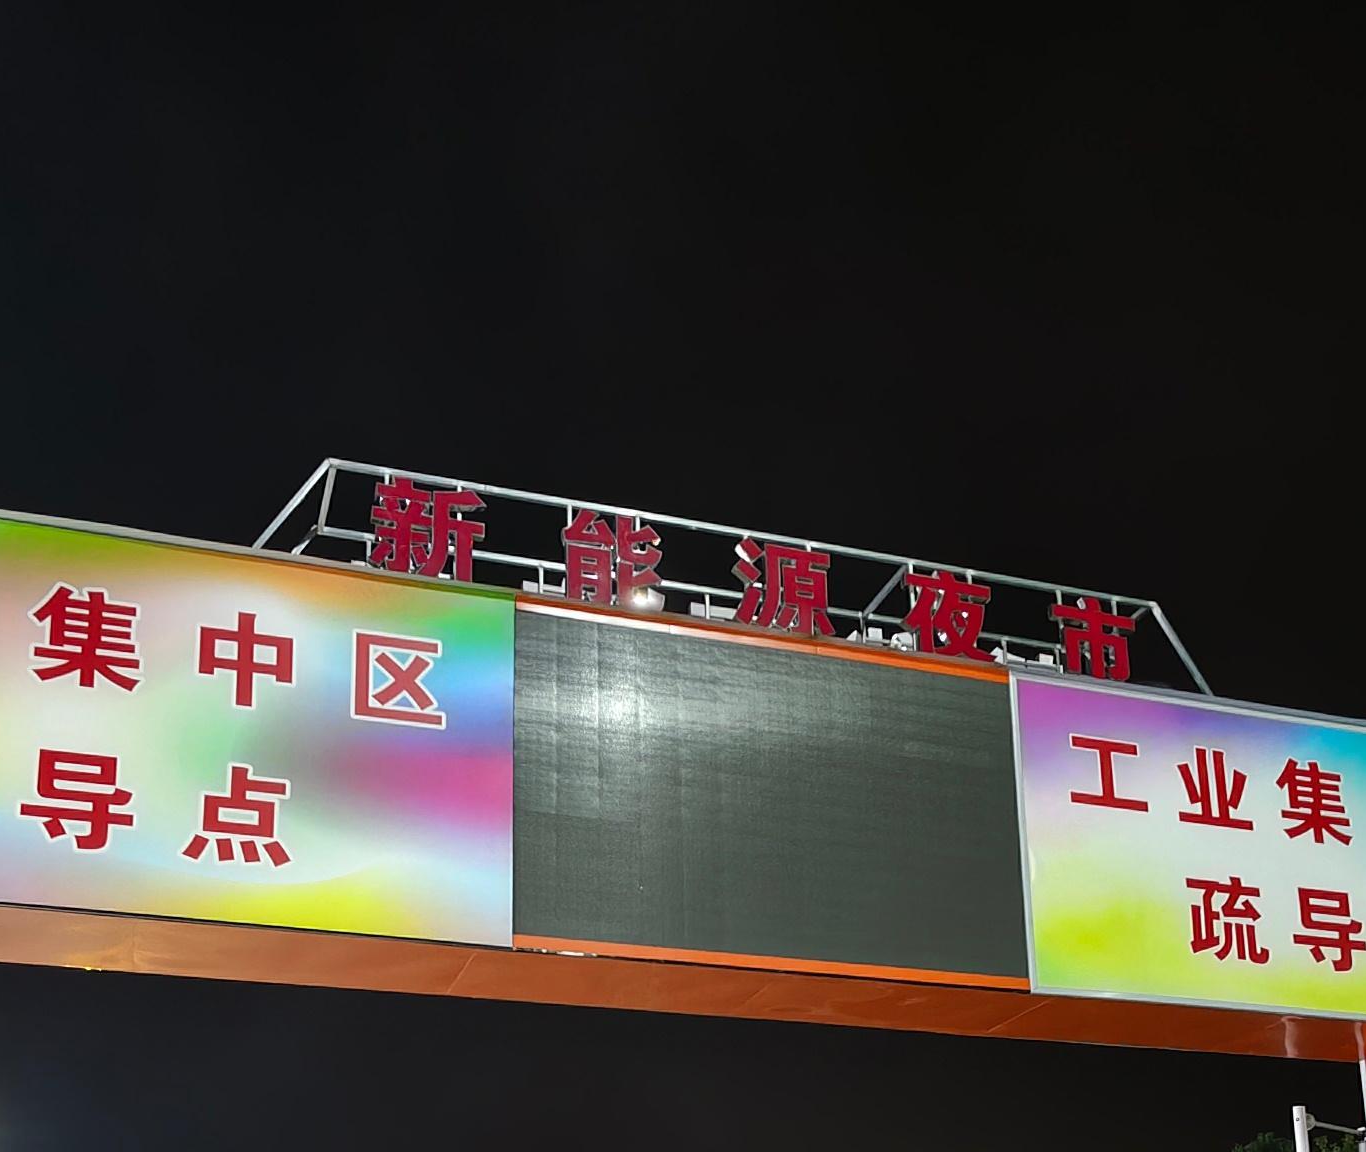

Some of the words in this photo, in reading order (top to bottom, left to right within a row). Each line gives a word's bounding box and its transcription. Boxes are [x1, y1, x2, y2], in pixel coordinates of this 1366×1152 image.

[368, 475, 1136, 683] 新能源夜市
